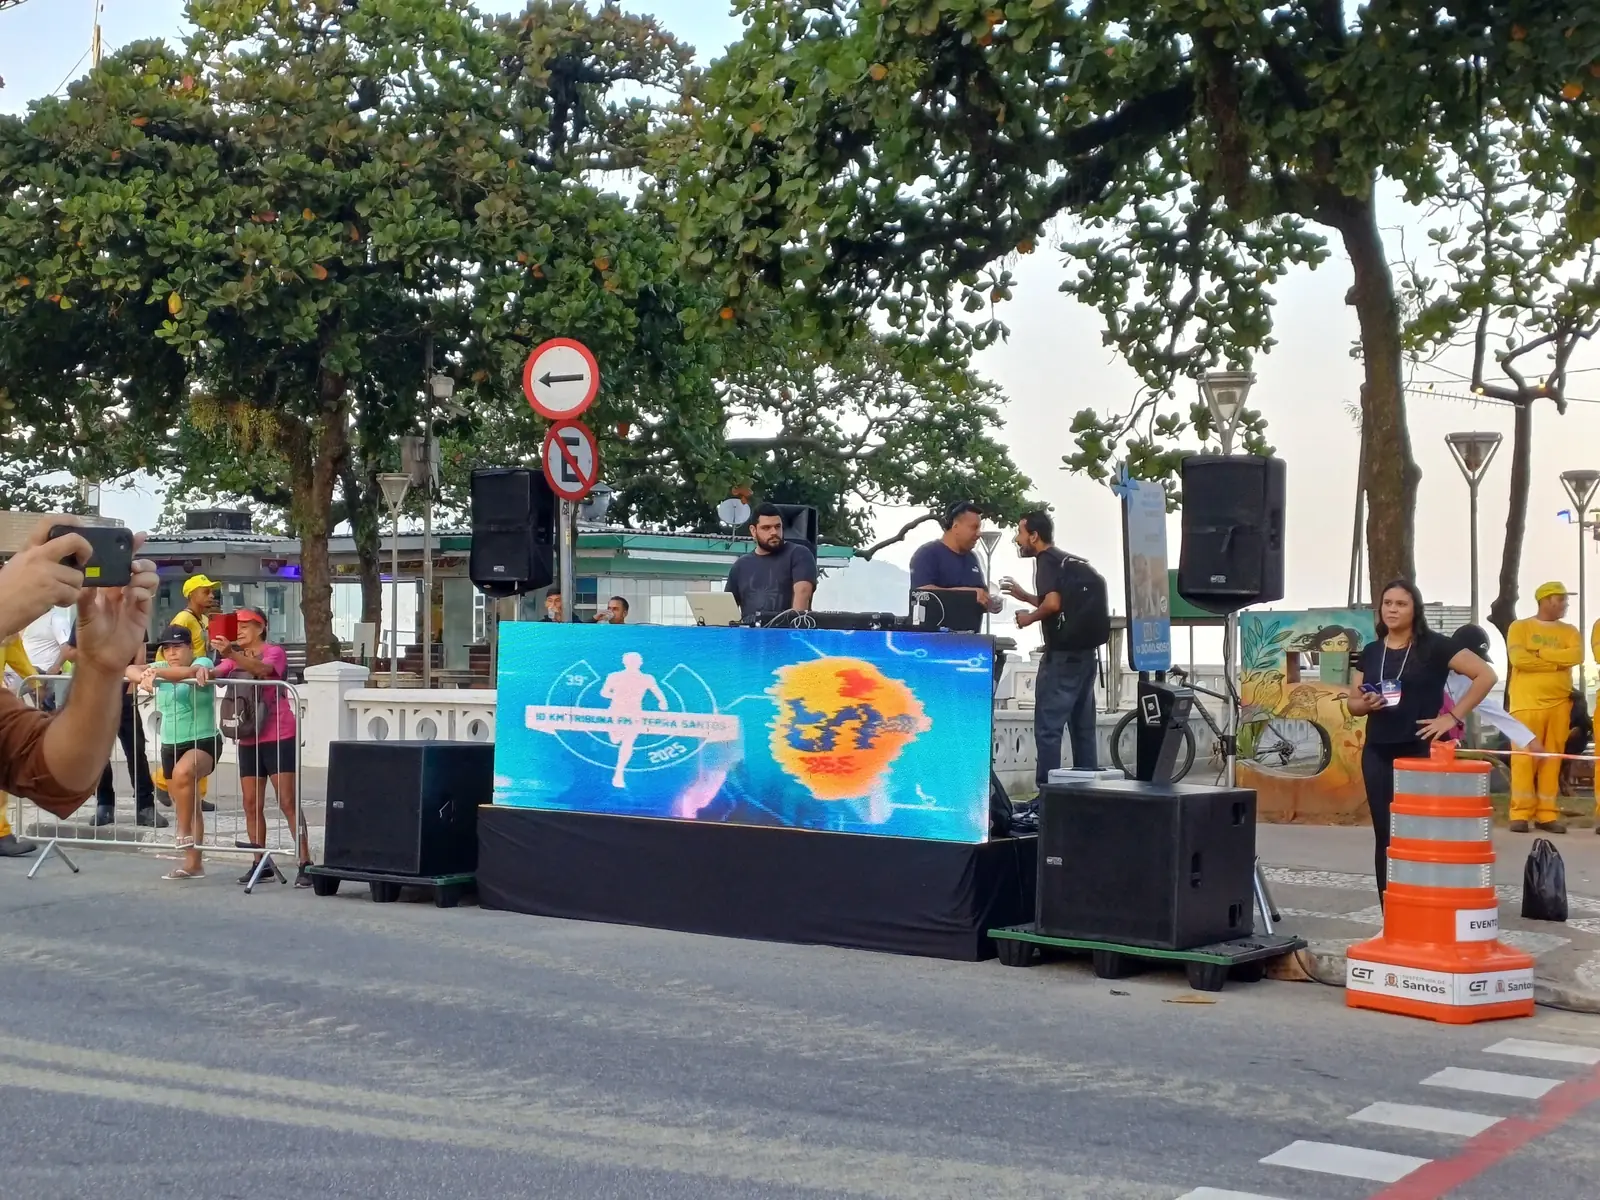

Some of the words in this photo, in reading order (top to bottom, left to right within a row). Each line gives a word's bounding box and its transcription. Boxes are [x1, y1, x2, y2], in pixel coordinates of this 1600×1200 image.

[549, 713, 564, 721] KM
[567, 713, 613, 724] TRIBUNA
[681, 719, 726, 730] SANTOS
[648, 742, 687, 763] 2025
[1352, 967, 1374, 979] CET
[1402, 979, 1446, 994] Santos
[1469, 980, 1488, 992] CET
